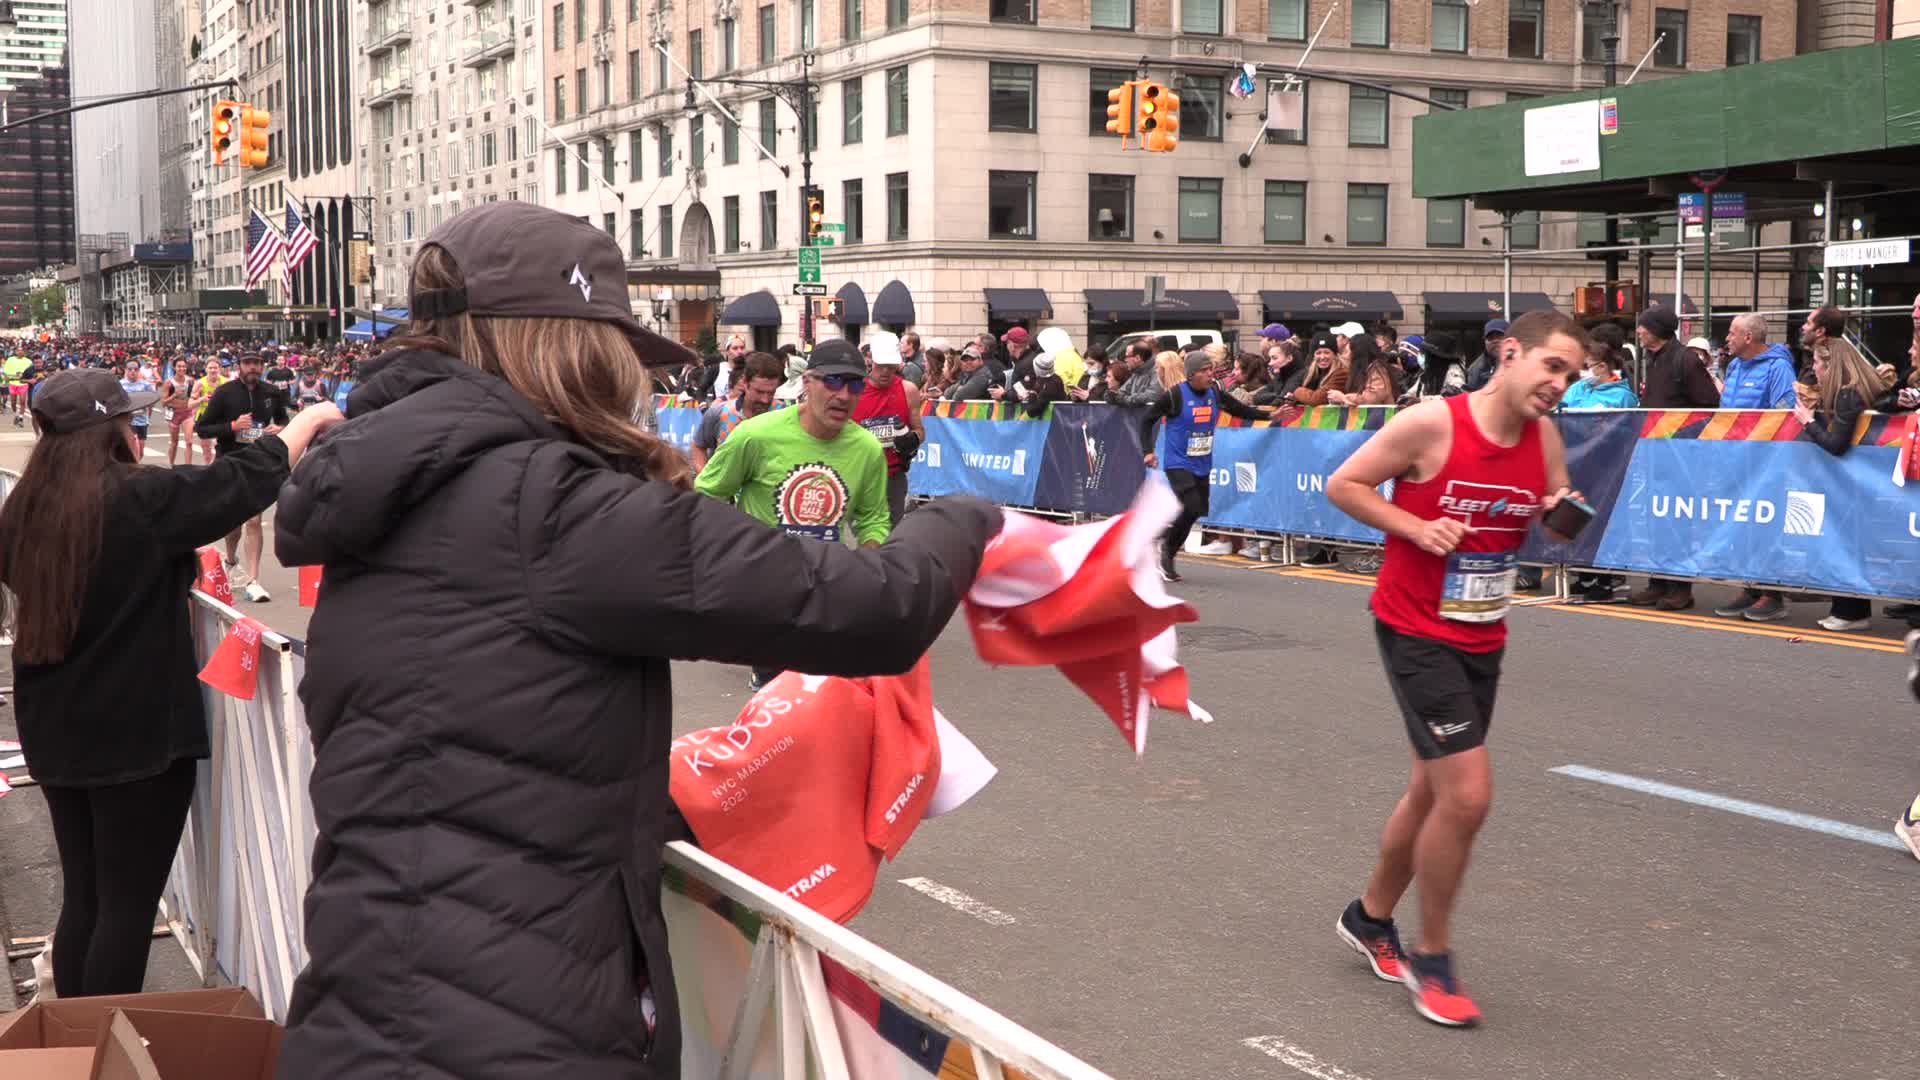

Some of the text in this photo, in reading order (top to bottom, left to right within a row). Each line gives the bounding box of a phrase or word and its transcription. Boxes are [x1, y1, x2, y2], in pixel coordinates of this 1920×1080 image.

[1680, 195, 1694, 206] M5
[962, 452, 1010, 470] UNITED
[1438, 495, 1491, 513] FLEET
[1652, 495, 1775, 524] UNITED
[712, 777, 737, 799] NYC
[736, 735, 795, 782] MARATHON
[720, 788, 748, 812] 2021
[885, 773, 925, 824] STRAVA
[783, 863, 837, 897] TRAVA
